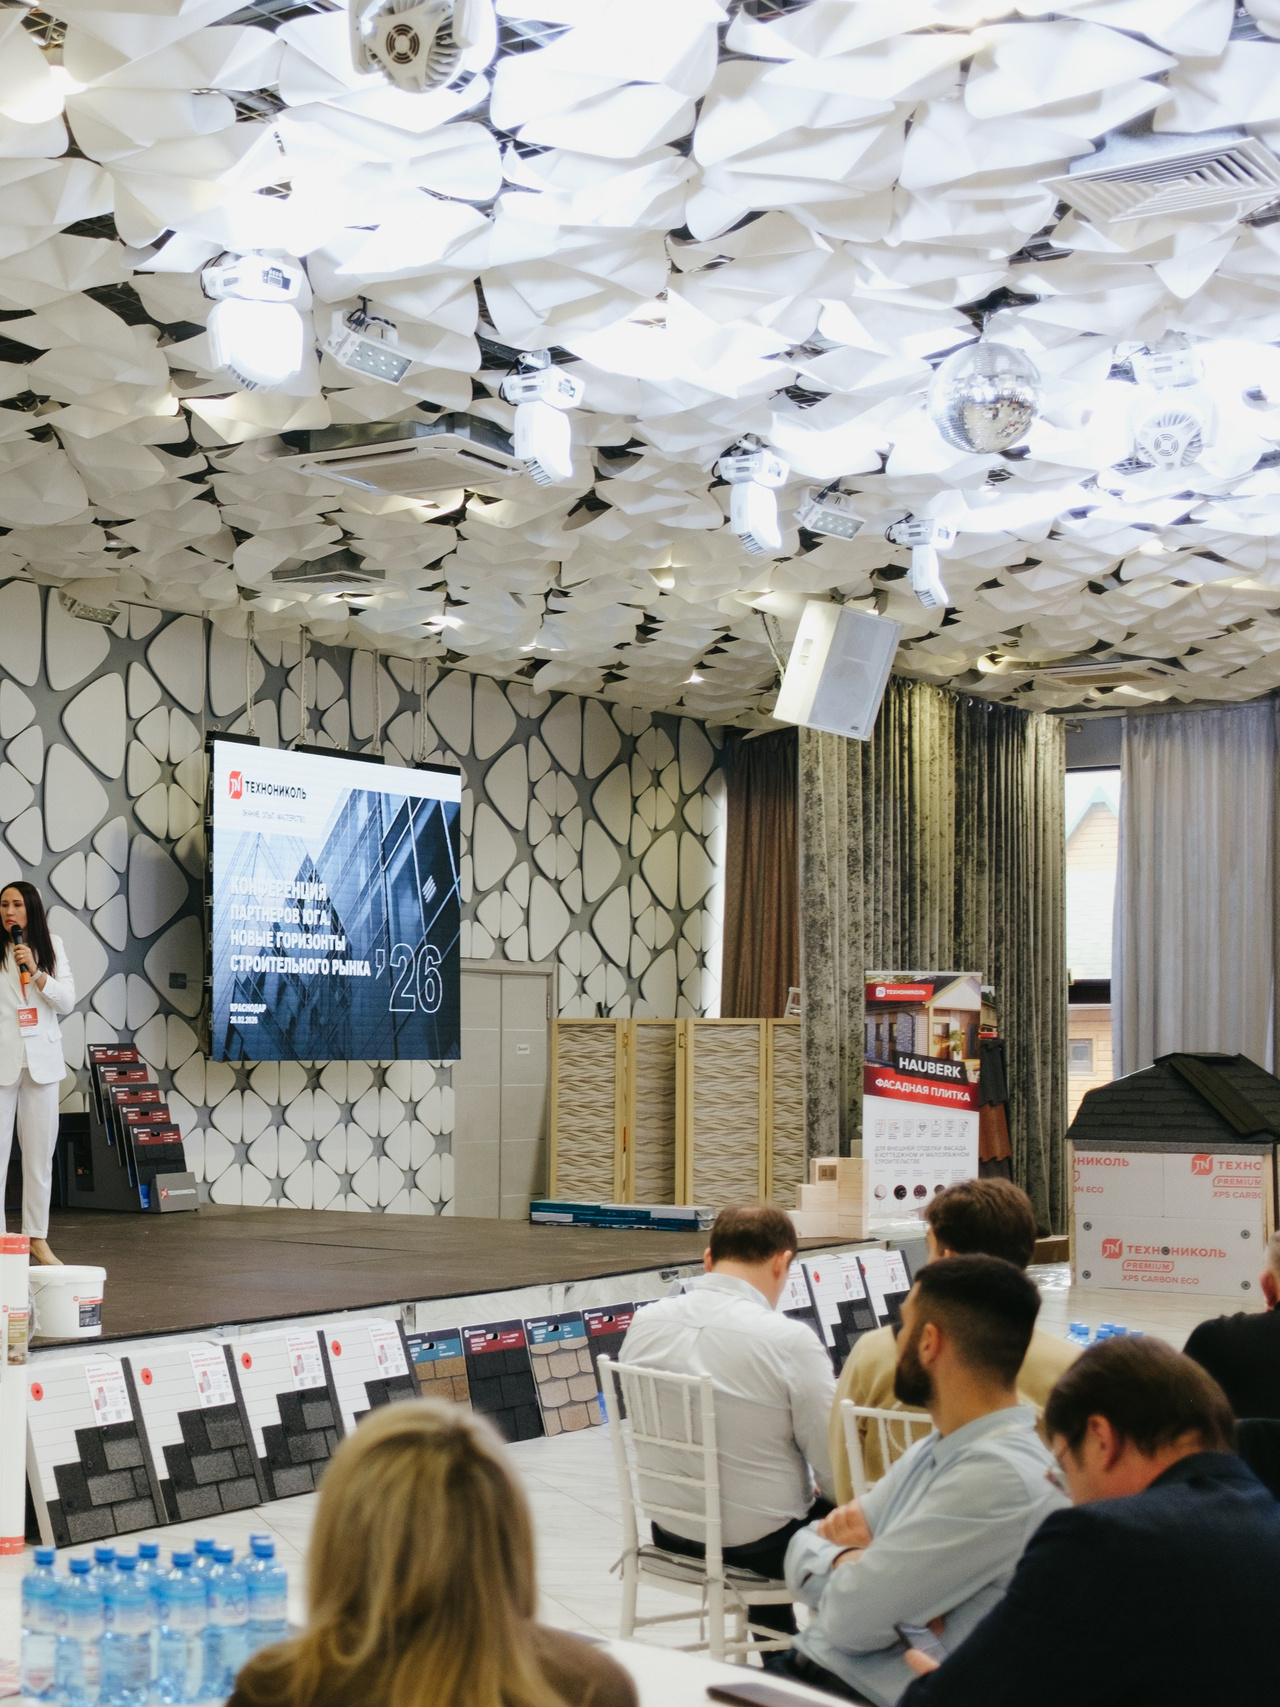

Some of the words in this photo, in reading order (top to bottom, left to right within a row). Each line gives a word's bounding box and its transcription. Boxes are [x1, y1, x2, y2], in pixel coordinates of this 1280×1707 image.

[245, 780, 307, 800] ТЕХНОНИКОЛЬ
[230, 876, 327, 903] КОНФЕРЕНЦИЯ
[230, 904, 300, 925] ПАРТНЕРОВ
[230, 930, 274, 948] НОВЫЕ
[275, 931, 346, 952] ГОРИЗОНТЫ
[230, 954, 330, 976] СТРОИТЕЛЬНОГО
[331, 958, 371, 977] РЫНКА
[898, 1057, 961, 1079] HAUBERK
[875, 1078, 930, 1095] ФАСАДНАЯ
[930, 1087, 971, 1102] ПЛИТКА
[1074, 1156, 1130, 1167] НИКОЛЬ
[1086, 1186, 1104, 1194] ECO
[1213, 1190, 1231, 1198] XPS
[1127, 1244, 1227, 1258] ТЕХННИКОЛЬ
[1126, 1262, 1170, 1271] PREMIUM
[1122, 1274, 1140, 1282] XPS
[1141, 1275, 1179, 1284] CARBON
